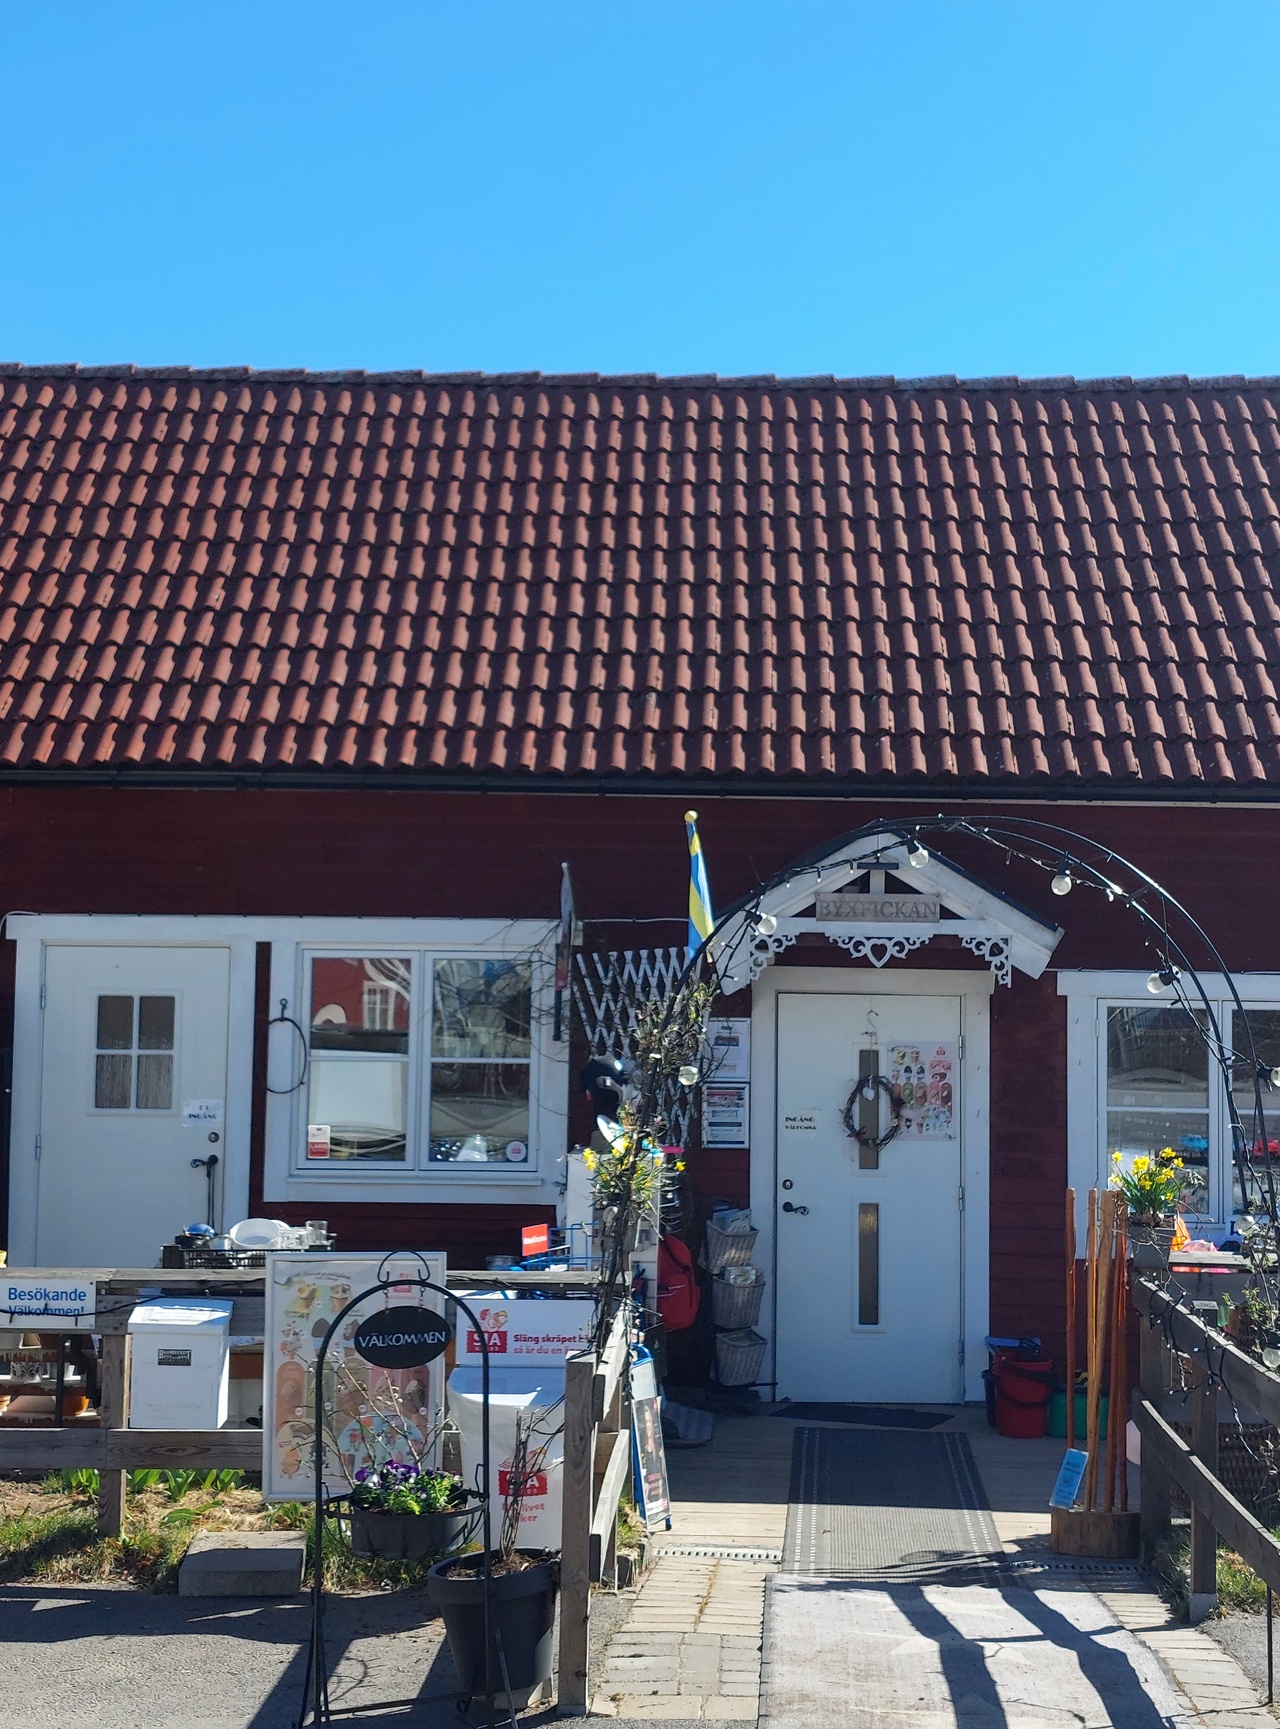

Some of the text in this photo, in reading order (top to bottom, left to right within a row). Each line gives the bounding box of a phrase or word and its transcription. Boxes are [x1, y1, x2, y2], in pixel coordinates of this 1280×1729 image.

[820, 900, 938, 919] BYXFICKAN
[8, 1286, 87, 1302] Besökande
[357, 1331, 446, 1348] VÄLKOMMEN
[514, 1334, 540, 1345] Släng
[541, 1334, 577, 1345] skräpet
